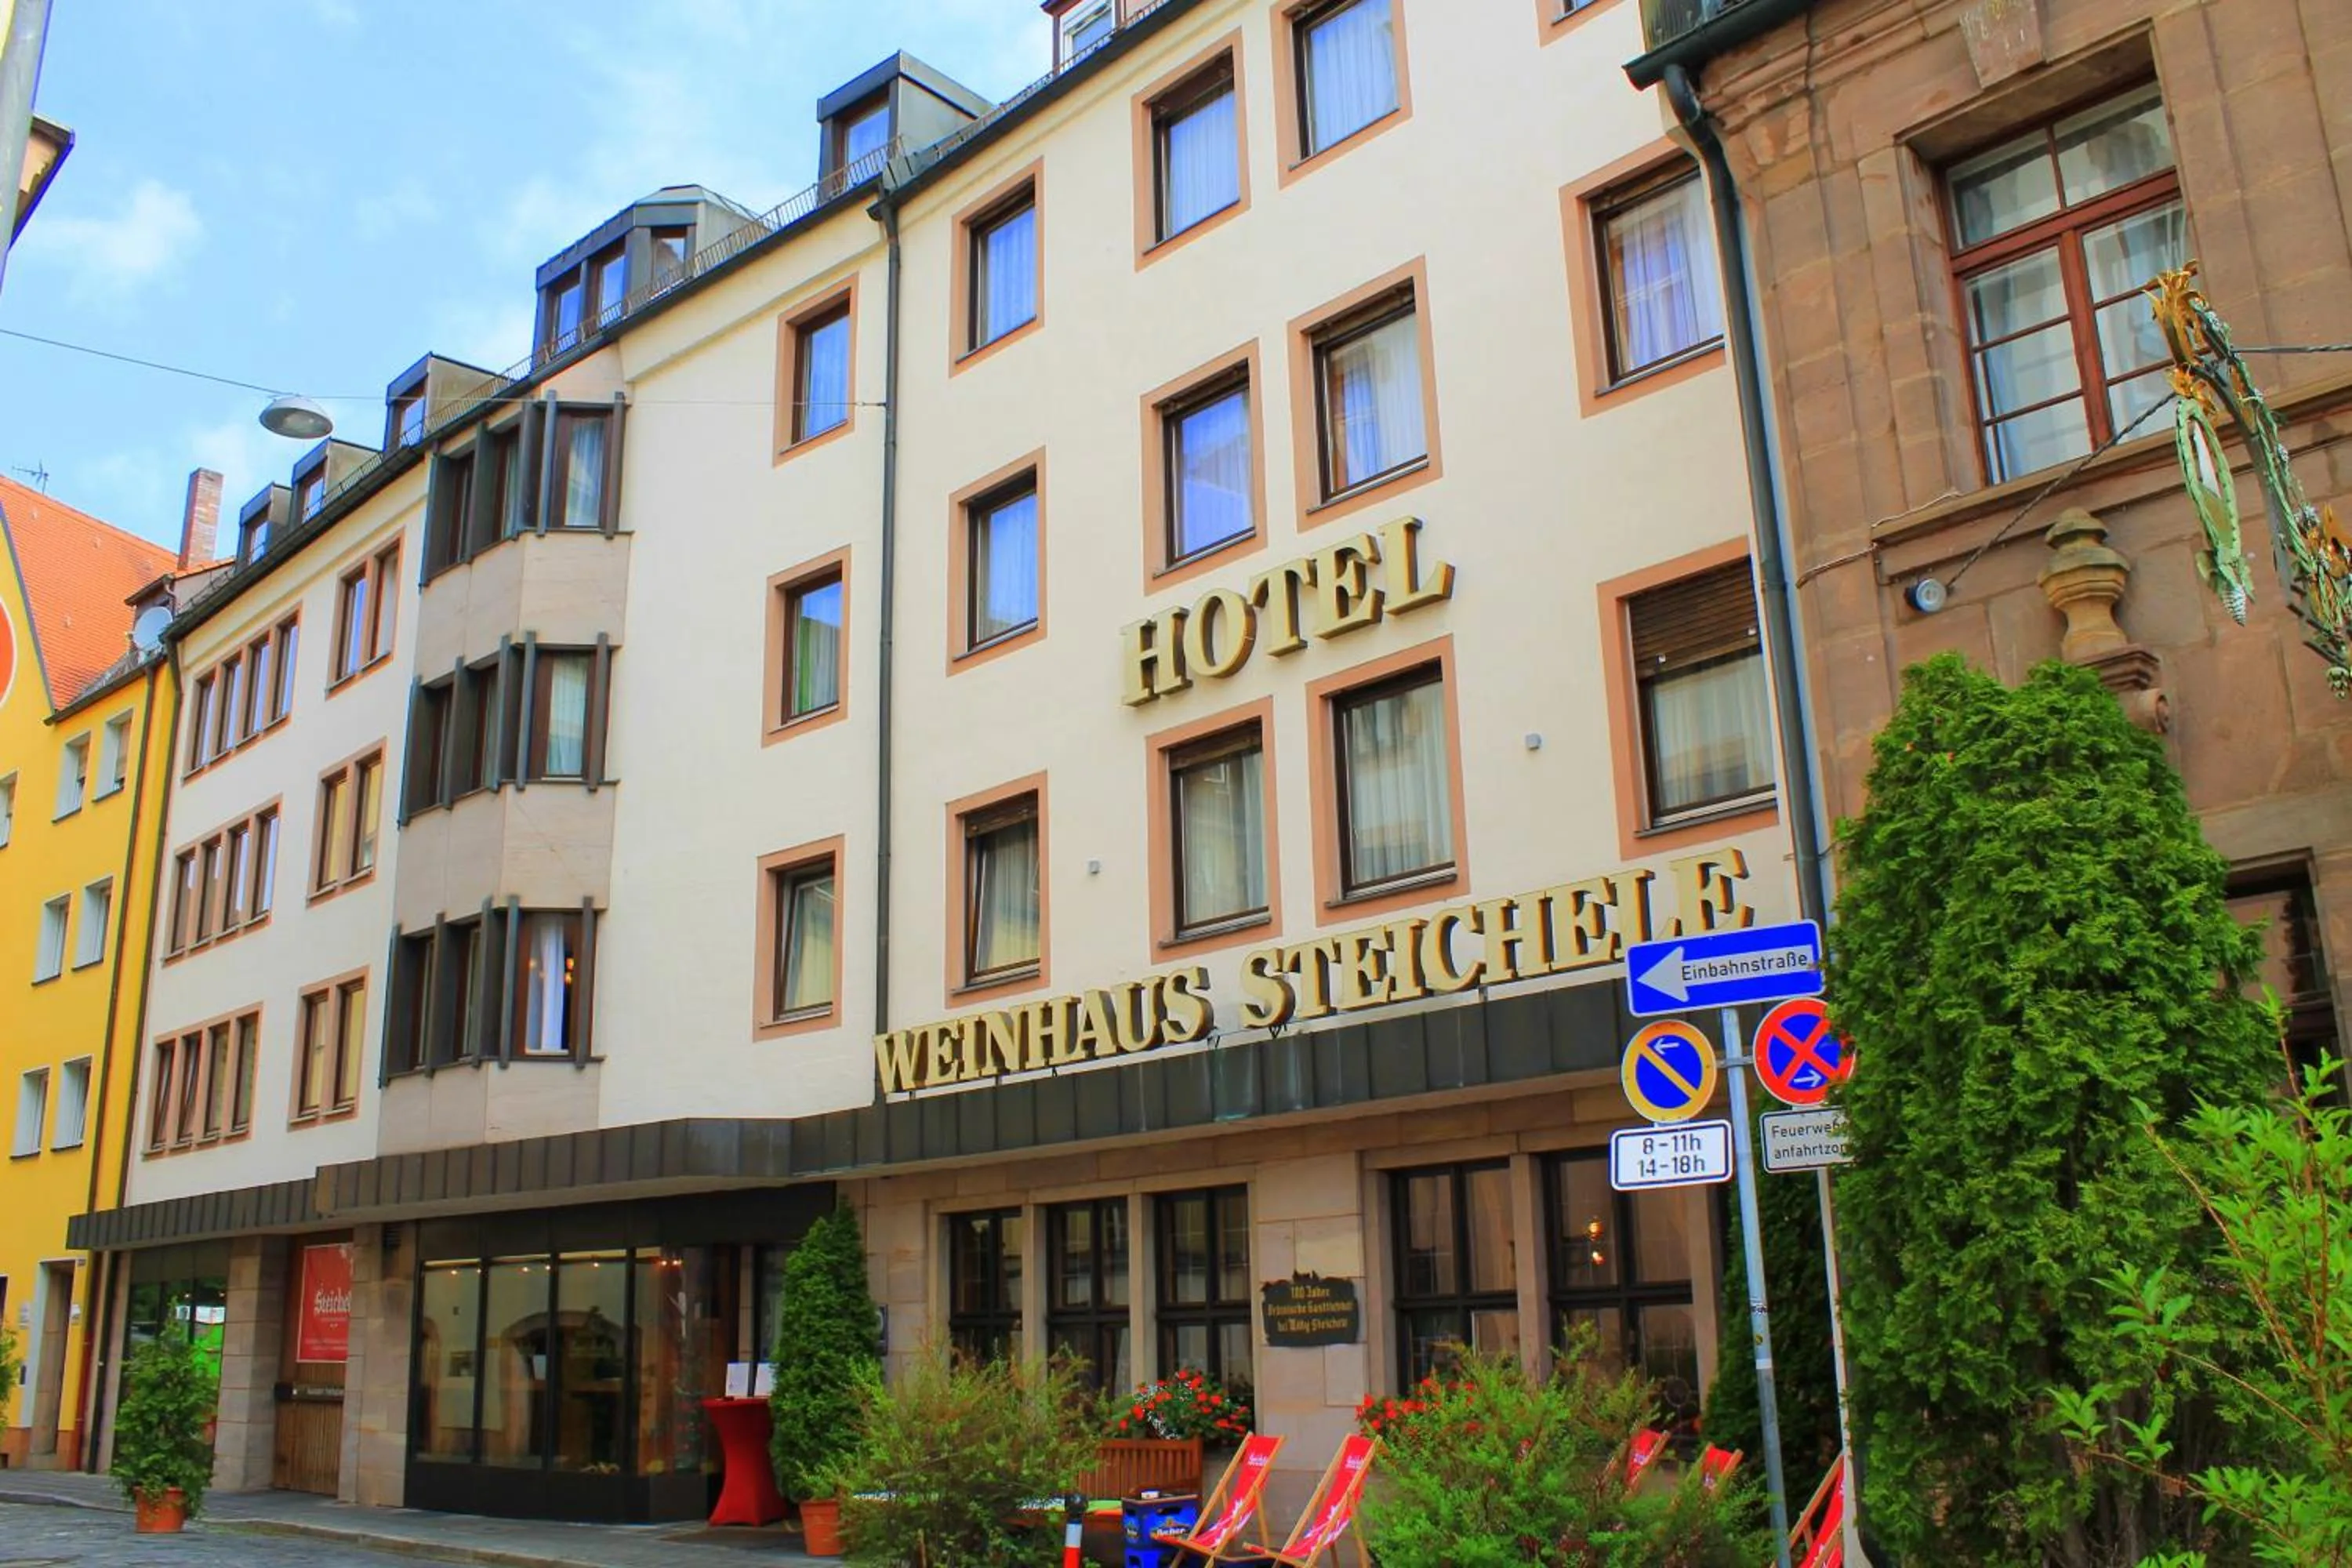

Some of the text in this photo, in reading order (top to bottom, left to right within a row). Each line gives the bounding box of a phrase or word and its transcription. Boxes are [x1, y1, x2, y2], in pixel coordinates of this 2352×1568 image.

[1120, 515, 1456, 707] HOTEL
[873, 846, 1755, 1095] WEINHAUS STEICHELE
[1681, 951, 1809, 981] Einbahnstraße
